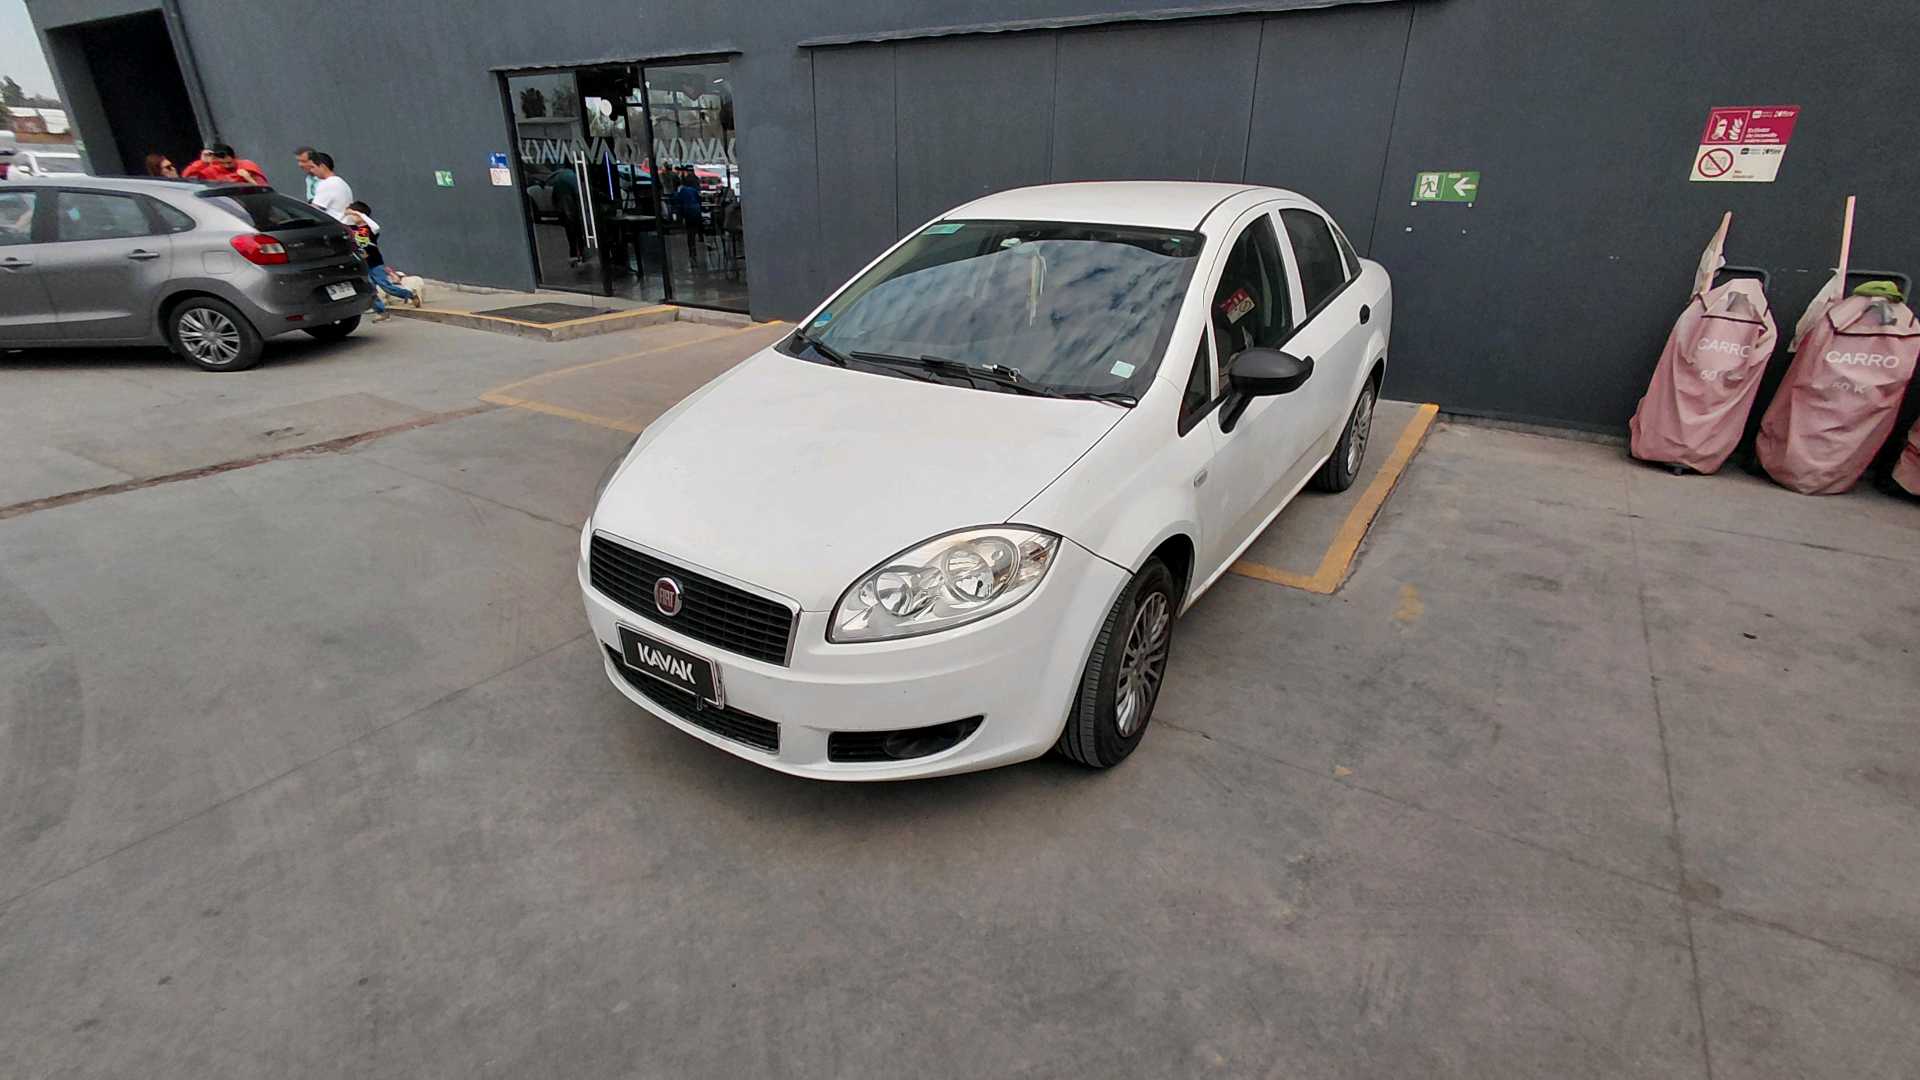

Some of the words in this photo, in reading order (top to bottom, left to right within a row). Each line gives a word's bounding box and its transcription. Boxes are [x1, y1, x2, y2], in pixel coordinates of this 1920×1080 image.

[1825, 350, 1900, 369] CARRO
[659, 588, 675, 607] FIAT
[637, 642, 697, 685] KAVAK
